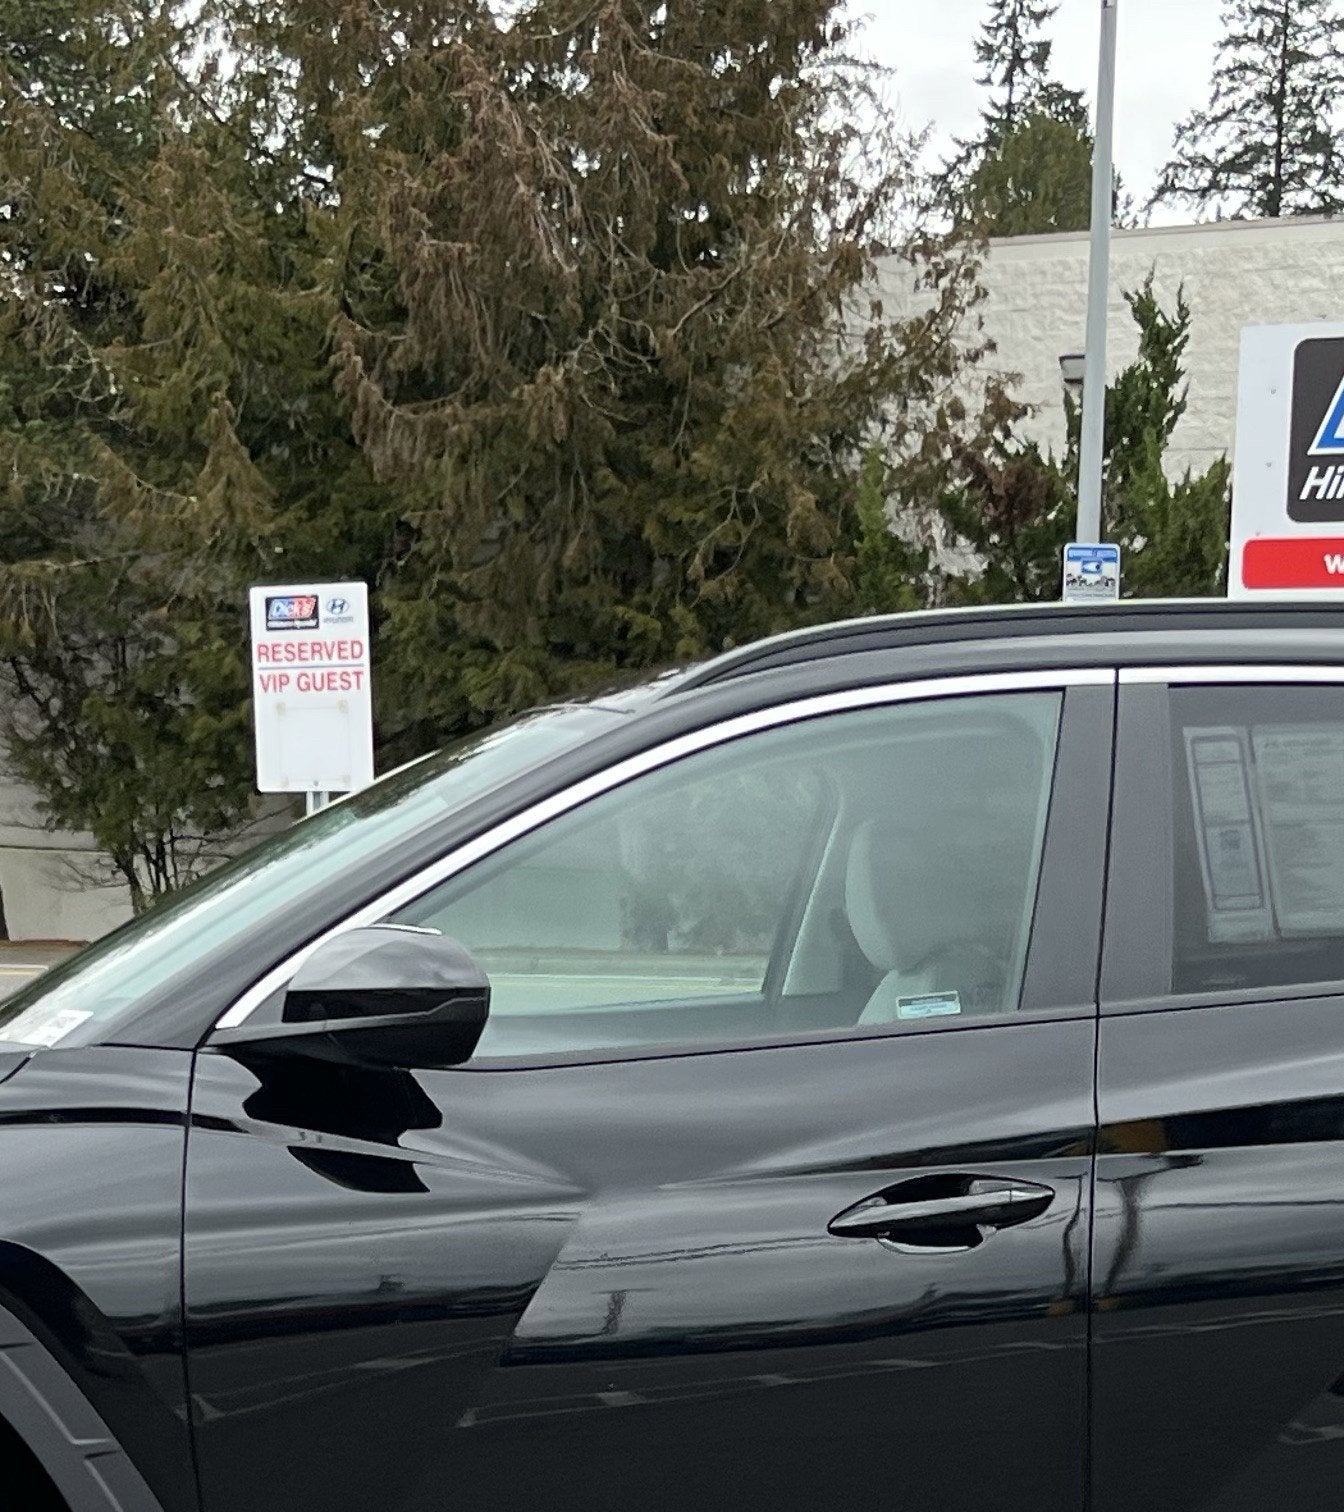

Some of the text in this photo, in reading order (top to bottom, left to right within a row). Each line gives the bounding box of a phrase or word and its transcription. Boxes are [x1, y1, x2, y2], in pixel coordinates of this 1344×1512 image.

[257, 640, 364, 663] RESERVED
[259, 671, 364, 693] VIP GUEST
